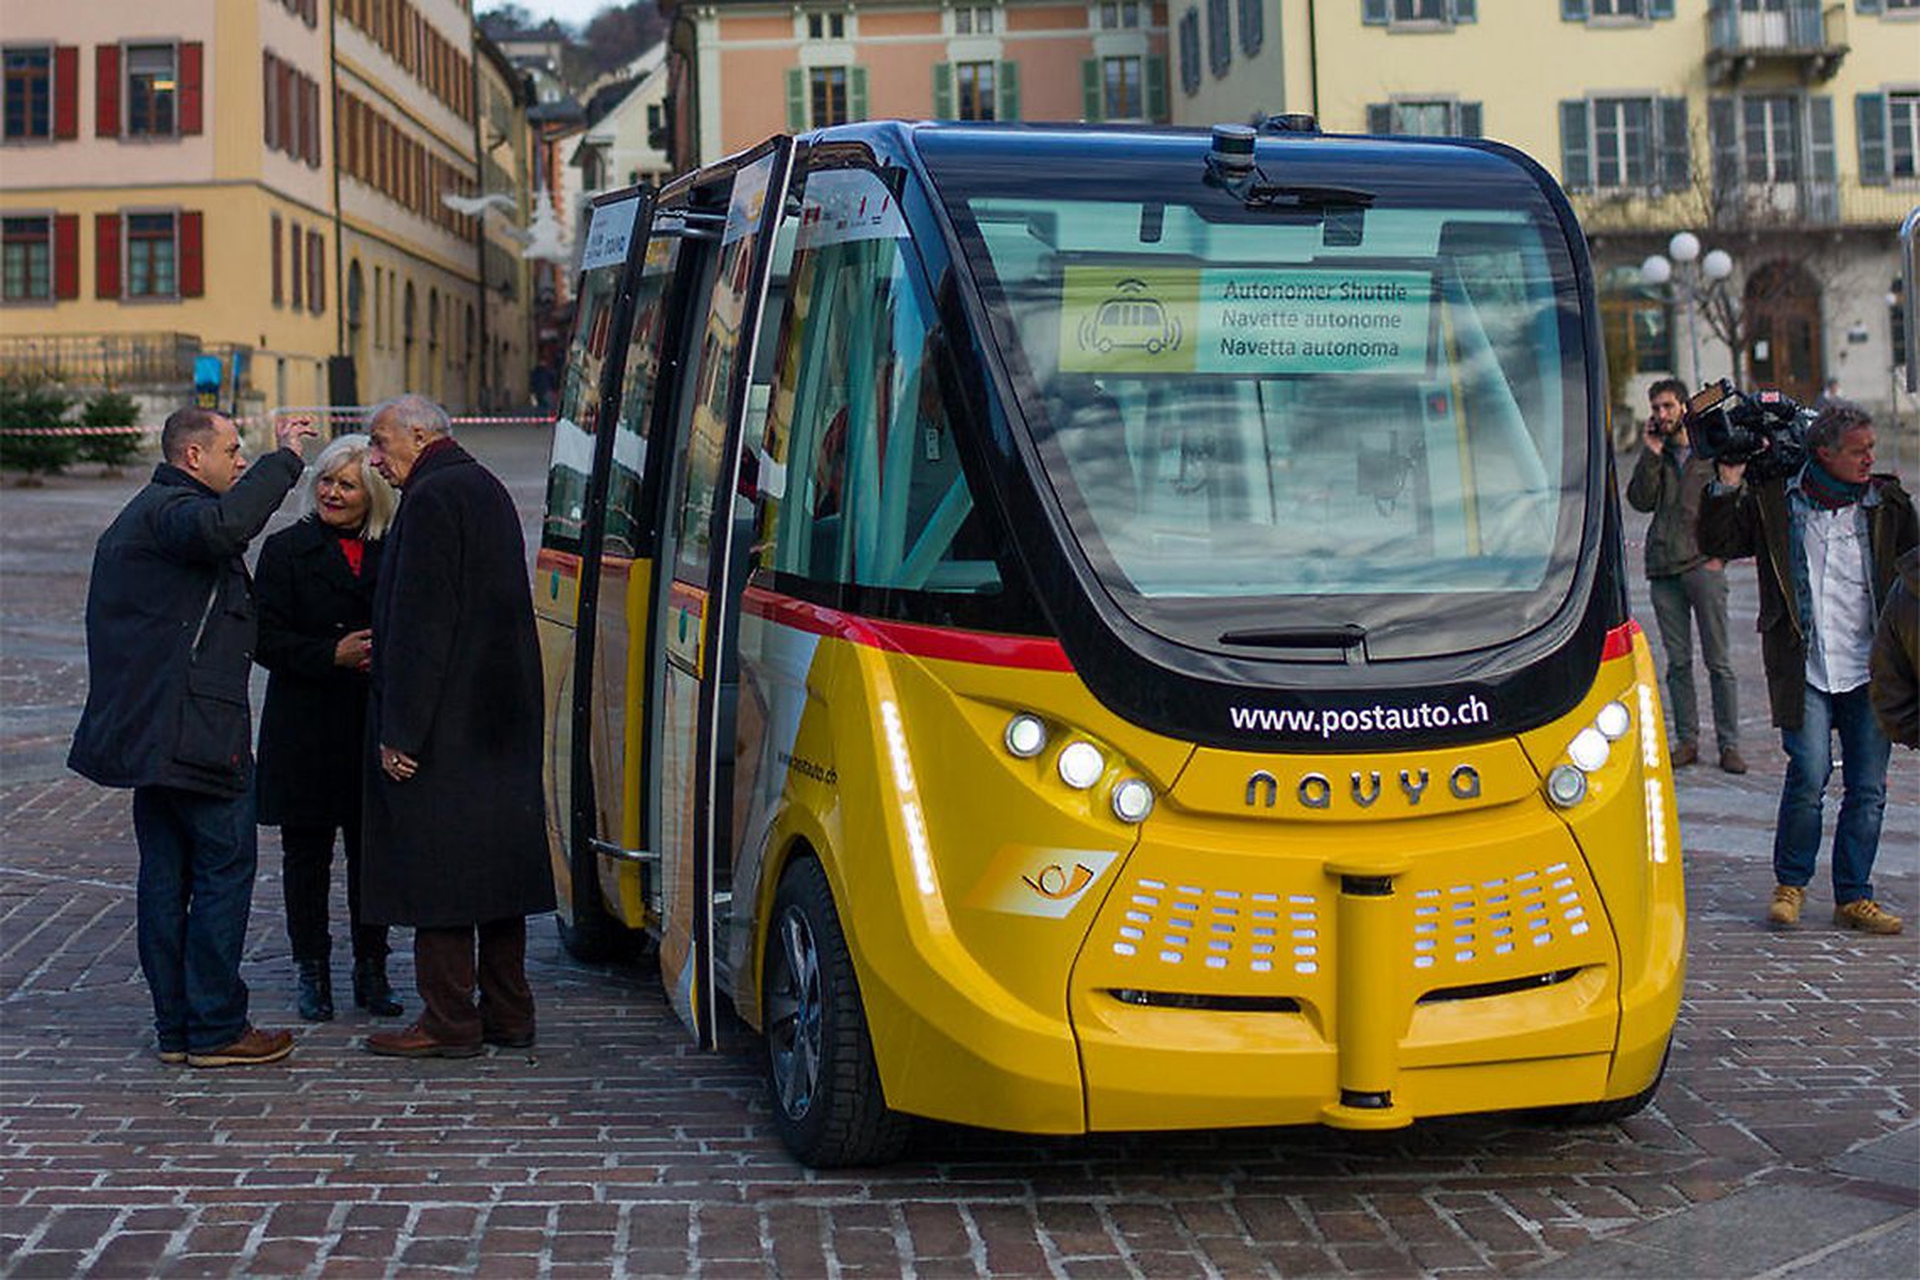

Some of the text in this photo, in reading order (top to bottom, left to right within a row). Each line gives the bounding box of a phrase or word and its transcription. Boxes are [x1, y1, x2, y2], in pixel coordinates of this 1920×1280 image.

[1223, 281, 1407, 301] Autonomer Shuttle
[1222, 309, 1401, 328] Navette autonome
[1220, 337, 1399, 357] Navetta autonoma
[1230, 695, 1489, 738] www.postauto.ch
